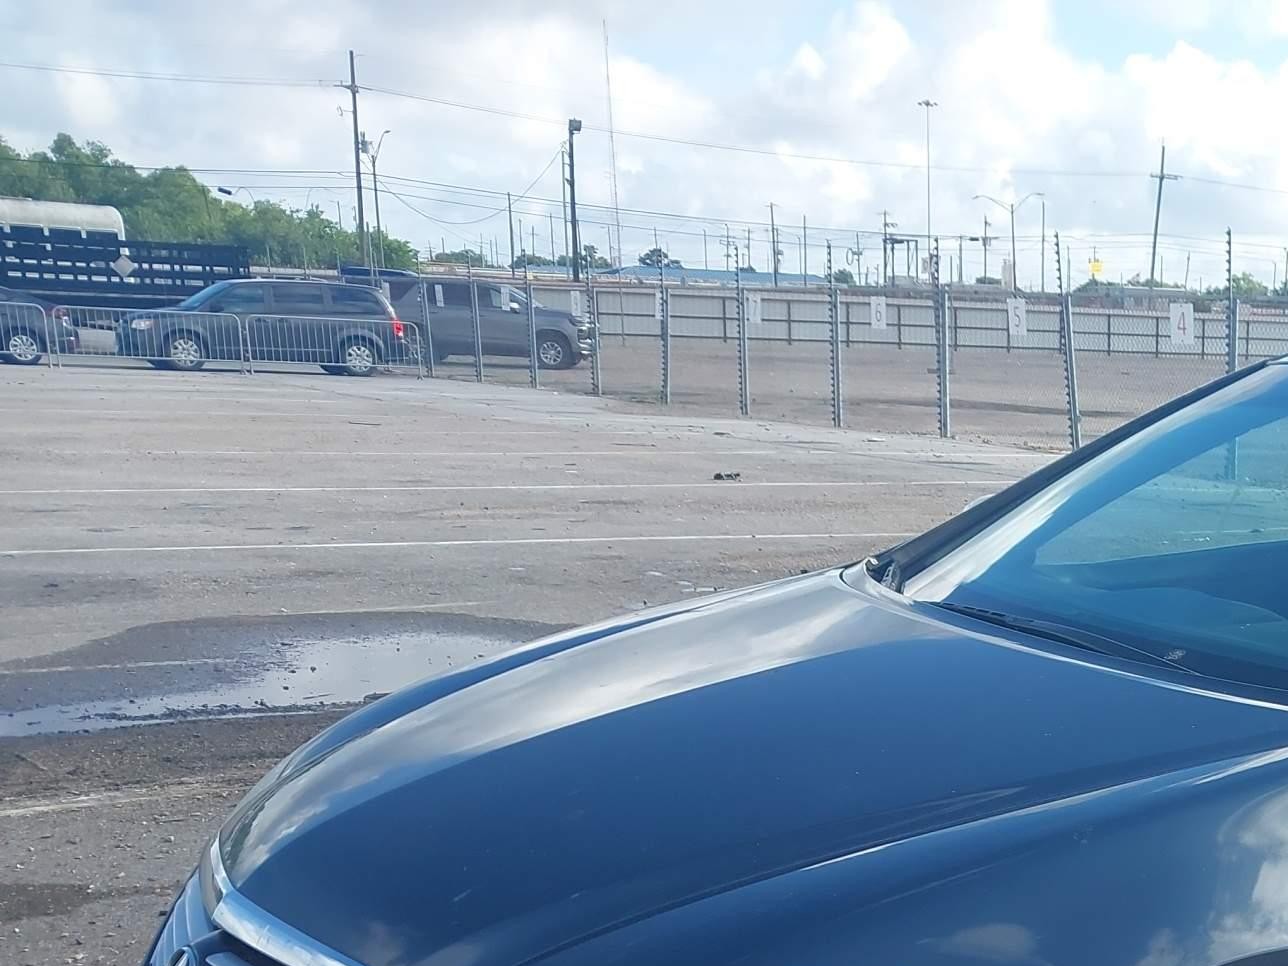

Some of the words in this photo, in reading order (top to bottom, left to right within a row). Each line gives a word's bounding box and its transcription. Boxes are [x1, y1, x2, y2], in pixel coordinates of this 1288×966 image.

[875, 303, 882, 322] 6
[1013, 306, 1021, 328] 5
[1176, 311, 1187, 336] 4
